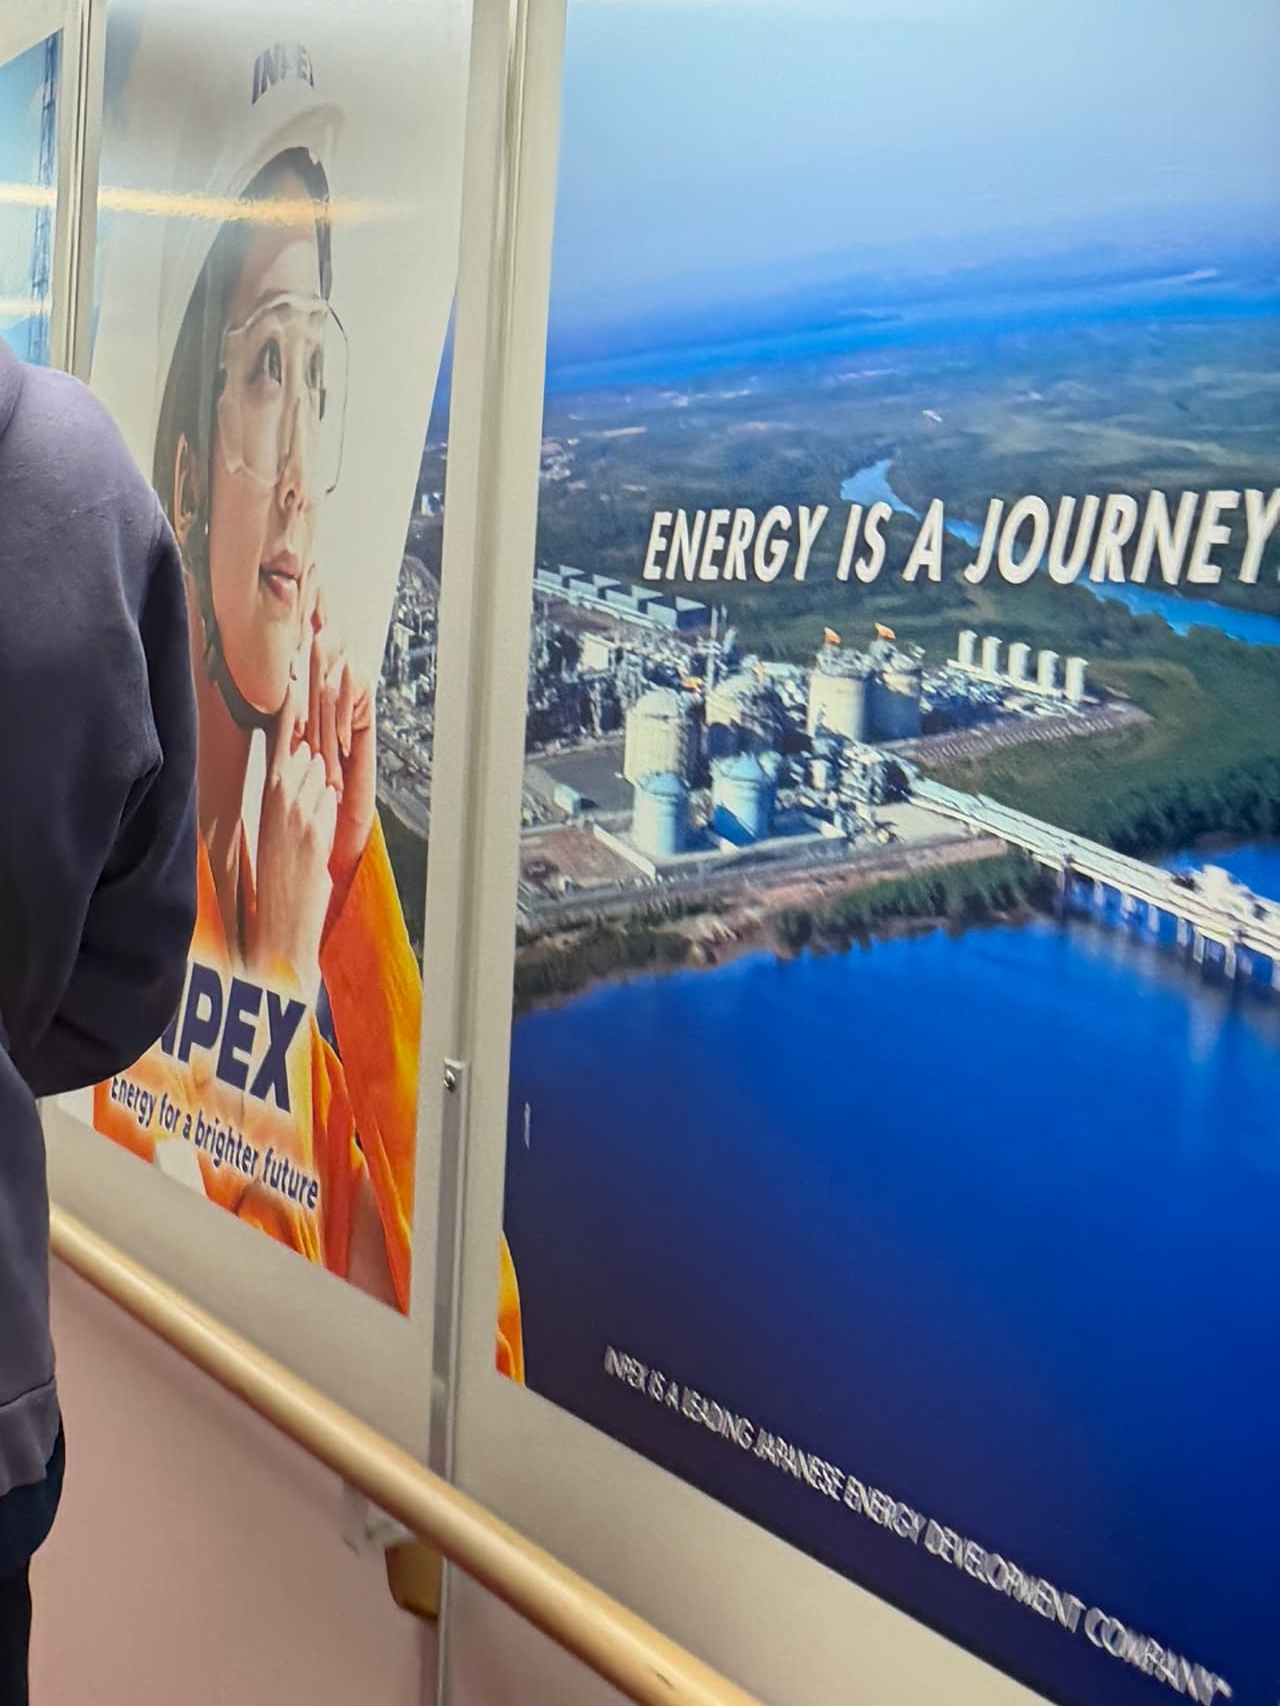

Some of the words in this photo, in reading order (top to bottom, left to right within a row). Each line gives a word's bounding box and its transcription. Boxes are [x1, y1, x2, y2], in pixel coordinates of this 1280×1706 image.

[643, 505, 829, 583] ENERGY
[837, 501, 893, 583] IS
[902, 498, 944, 582] A
[160, 962, 307, 1114] PEX
[159, 1093, 181, 1133] for
[182, 1113, 194, 1141] a
[194, 1111, 259, 1176] brighter
[262, 1147, 319, 1210] future
[665, 1381, 680, 1411] A
[680, 1387, 755, 1450] LEADING
[752, 1427, 846, 1501] JAPANESE
[843, 1474, 928, 1544] ENERGY
[924, 1518, 1087, 1634] DEVELOPMENT
